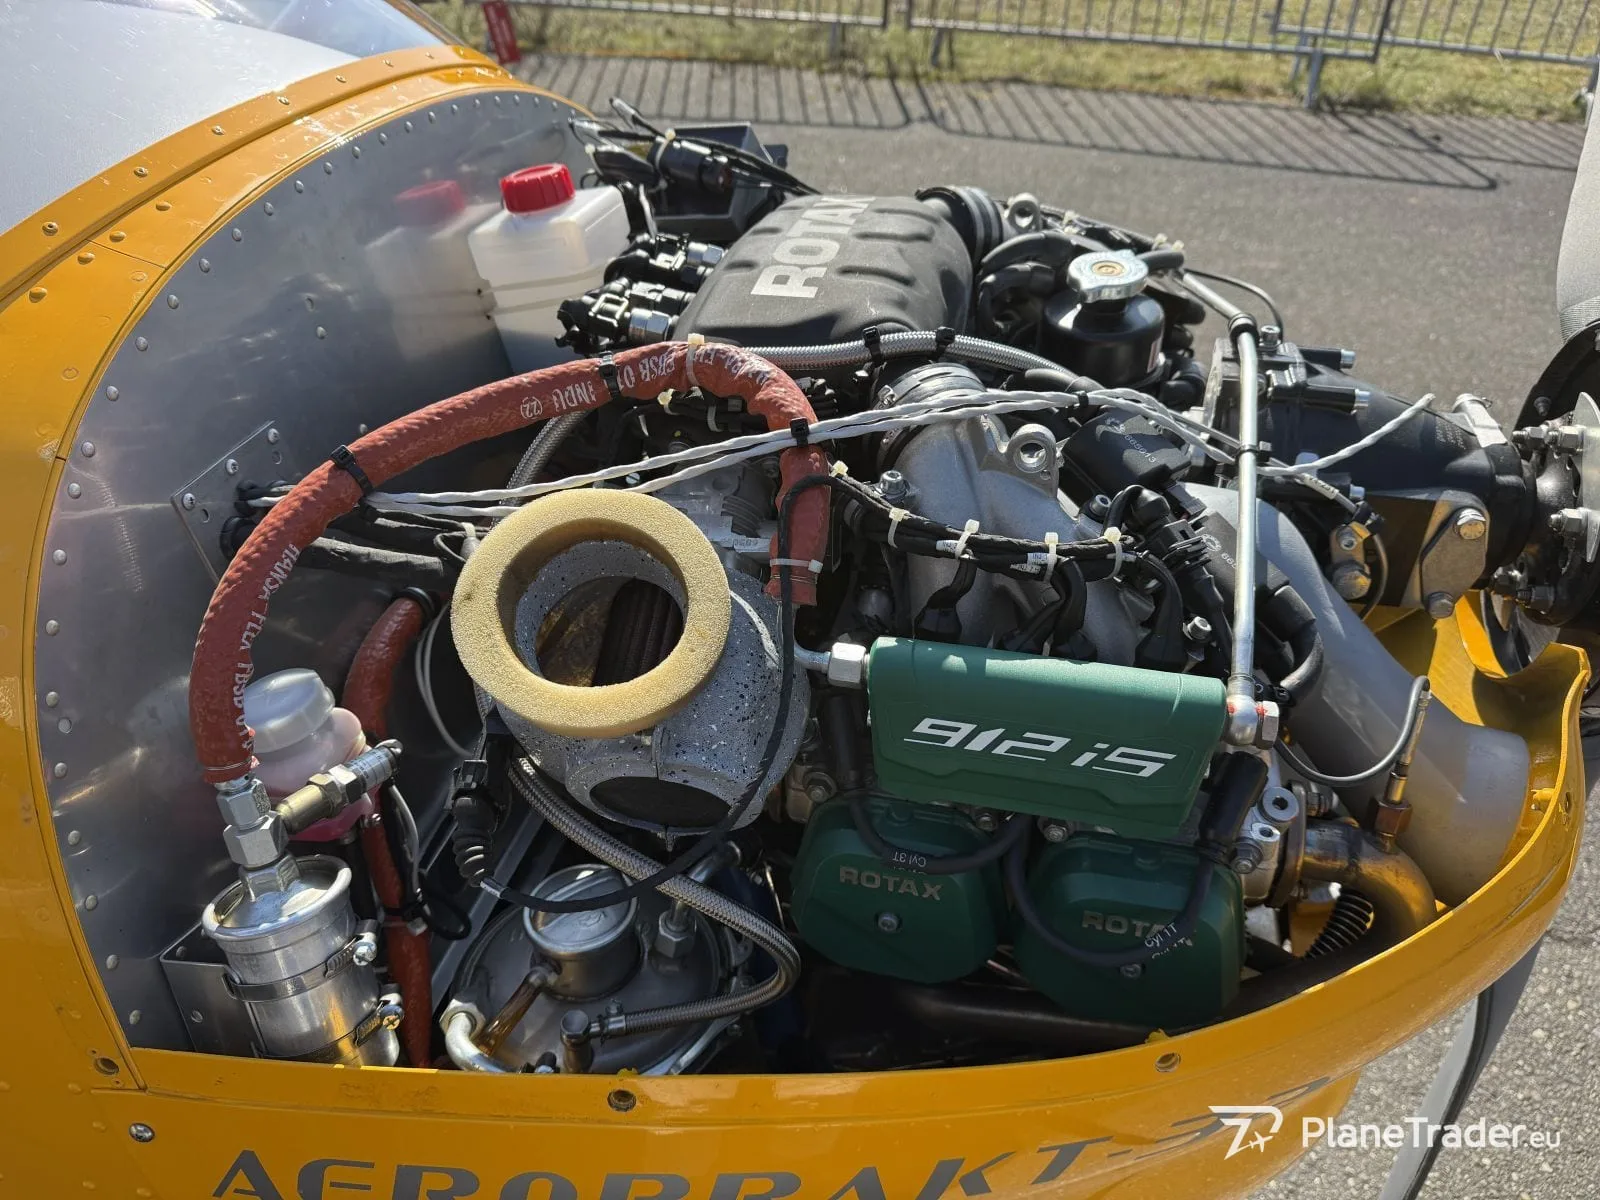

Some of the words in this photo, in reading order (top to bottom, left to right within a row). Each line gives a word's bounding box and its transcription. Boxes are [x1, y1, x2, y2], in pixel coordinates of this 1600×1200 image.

[903, 716, 1073, 762] 912
[1070, 742, 1179, 779] iS
[839, 865, 943, 902] ROTAX
[1144, 932, 1164, 949] Cyl
